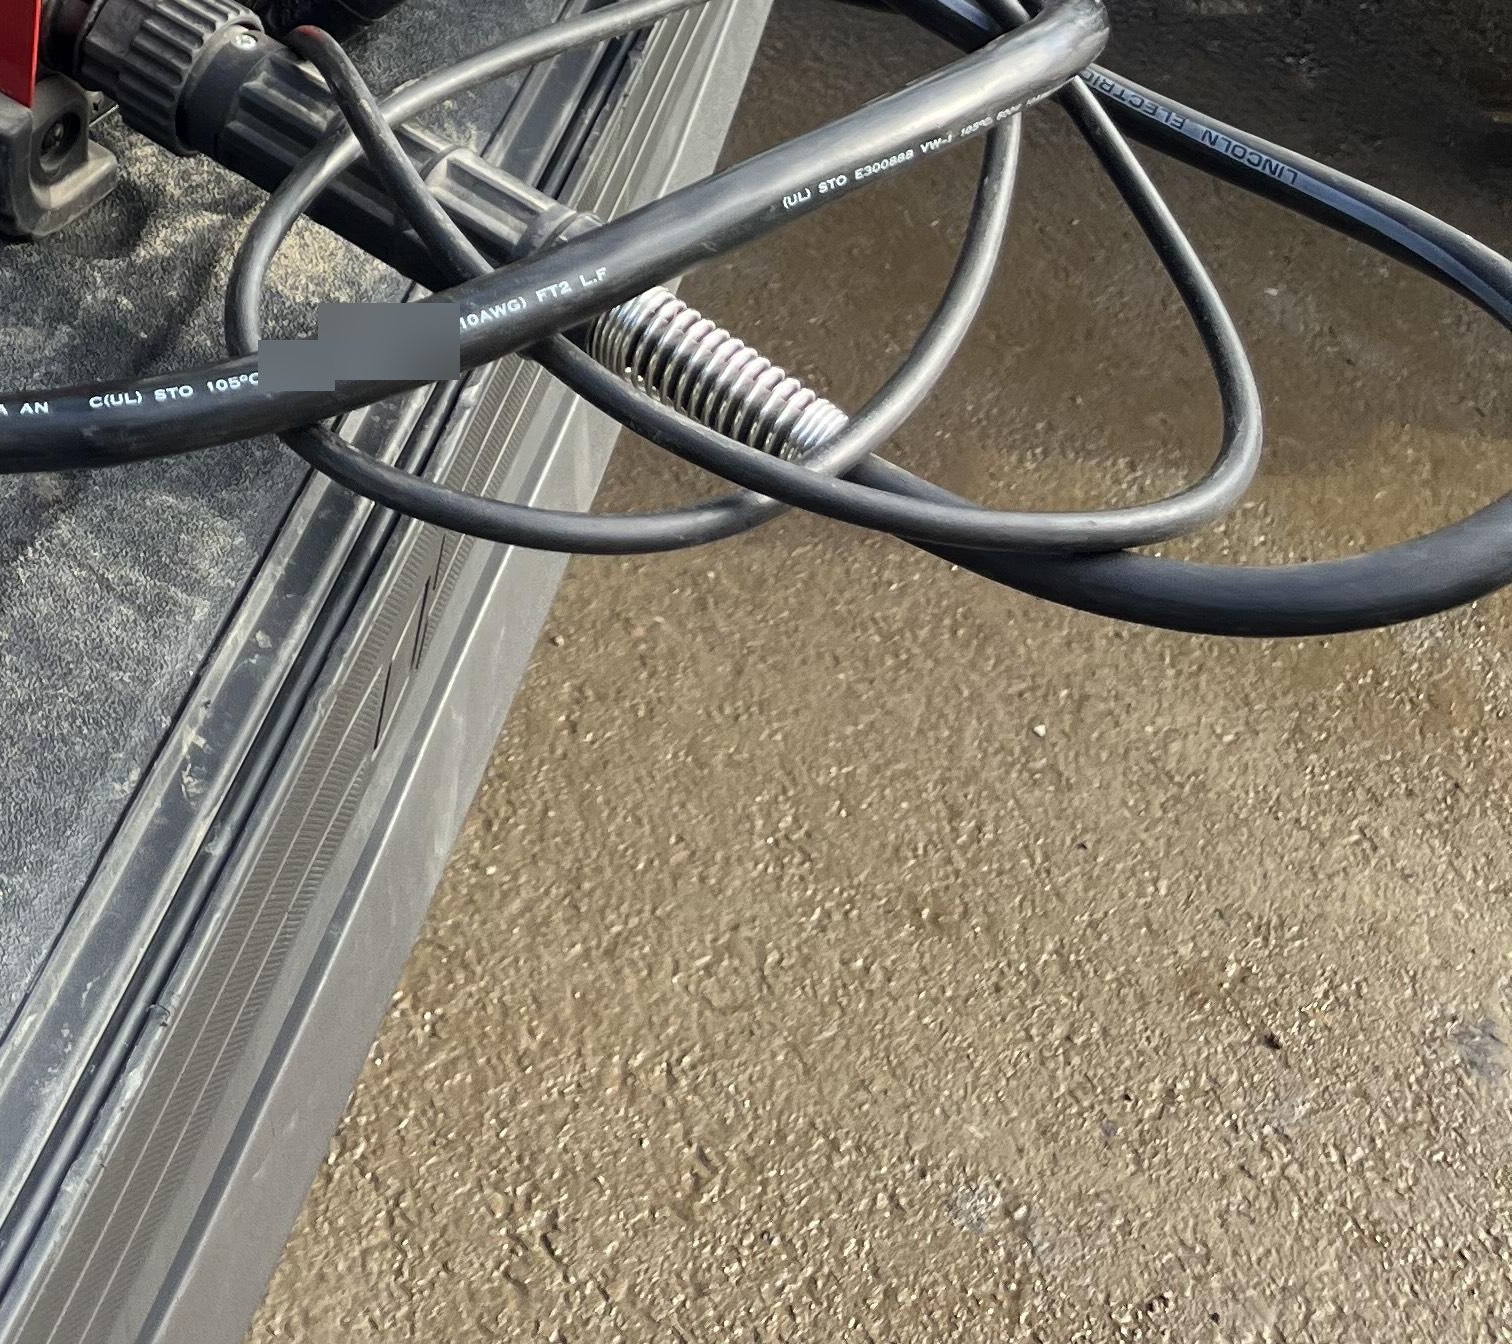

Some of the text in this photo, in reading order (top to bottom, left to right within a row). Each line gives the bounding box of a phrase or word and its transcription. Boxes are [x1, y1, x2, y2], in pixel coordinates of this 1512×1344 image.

[1201, 129, 1299, 186] LINCOLN
[782, 187, 812, 209] (UL)
[818, 174, 848, 194] STO
[854, 149, 914, 181] E300888
[920, 133, 953, 154] VW-1
[535, 280, 573, 303] FT2
[19, 401, 50, 415] AN
[88, 390, 143, 409] C(UL)
[153, 385, 194, 402] STO
